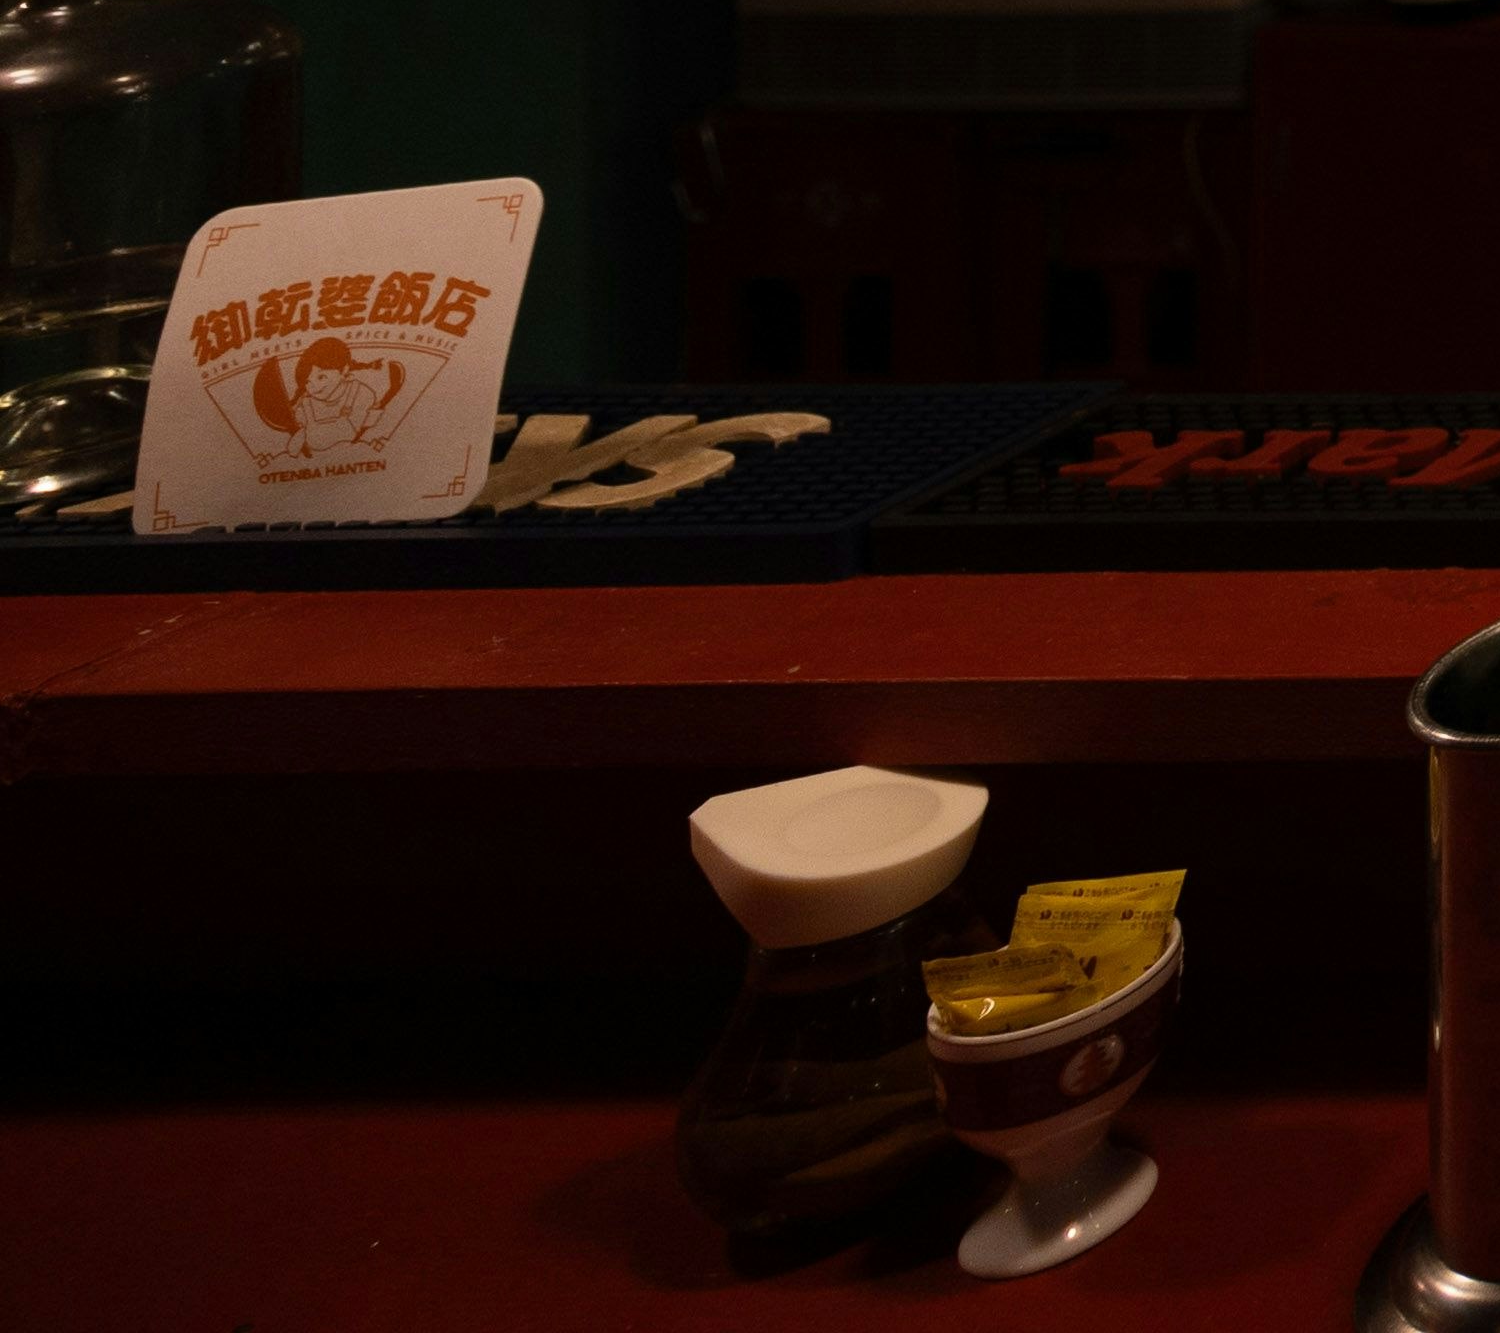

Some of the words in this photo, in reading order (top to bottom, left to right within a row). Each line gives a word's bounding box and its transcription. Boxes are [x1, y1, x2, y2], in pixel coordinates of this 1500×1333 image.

[345, 330, 391, 341] SPICE
[258, 466, 322, 485] OTENBA
[324, 459, 388, 480] HANTEN
